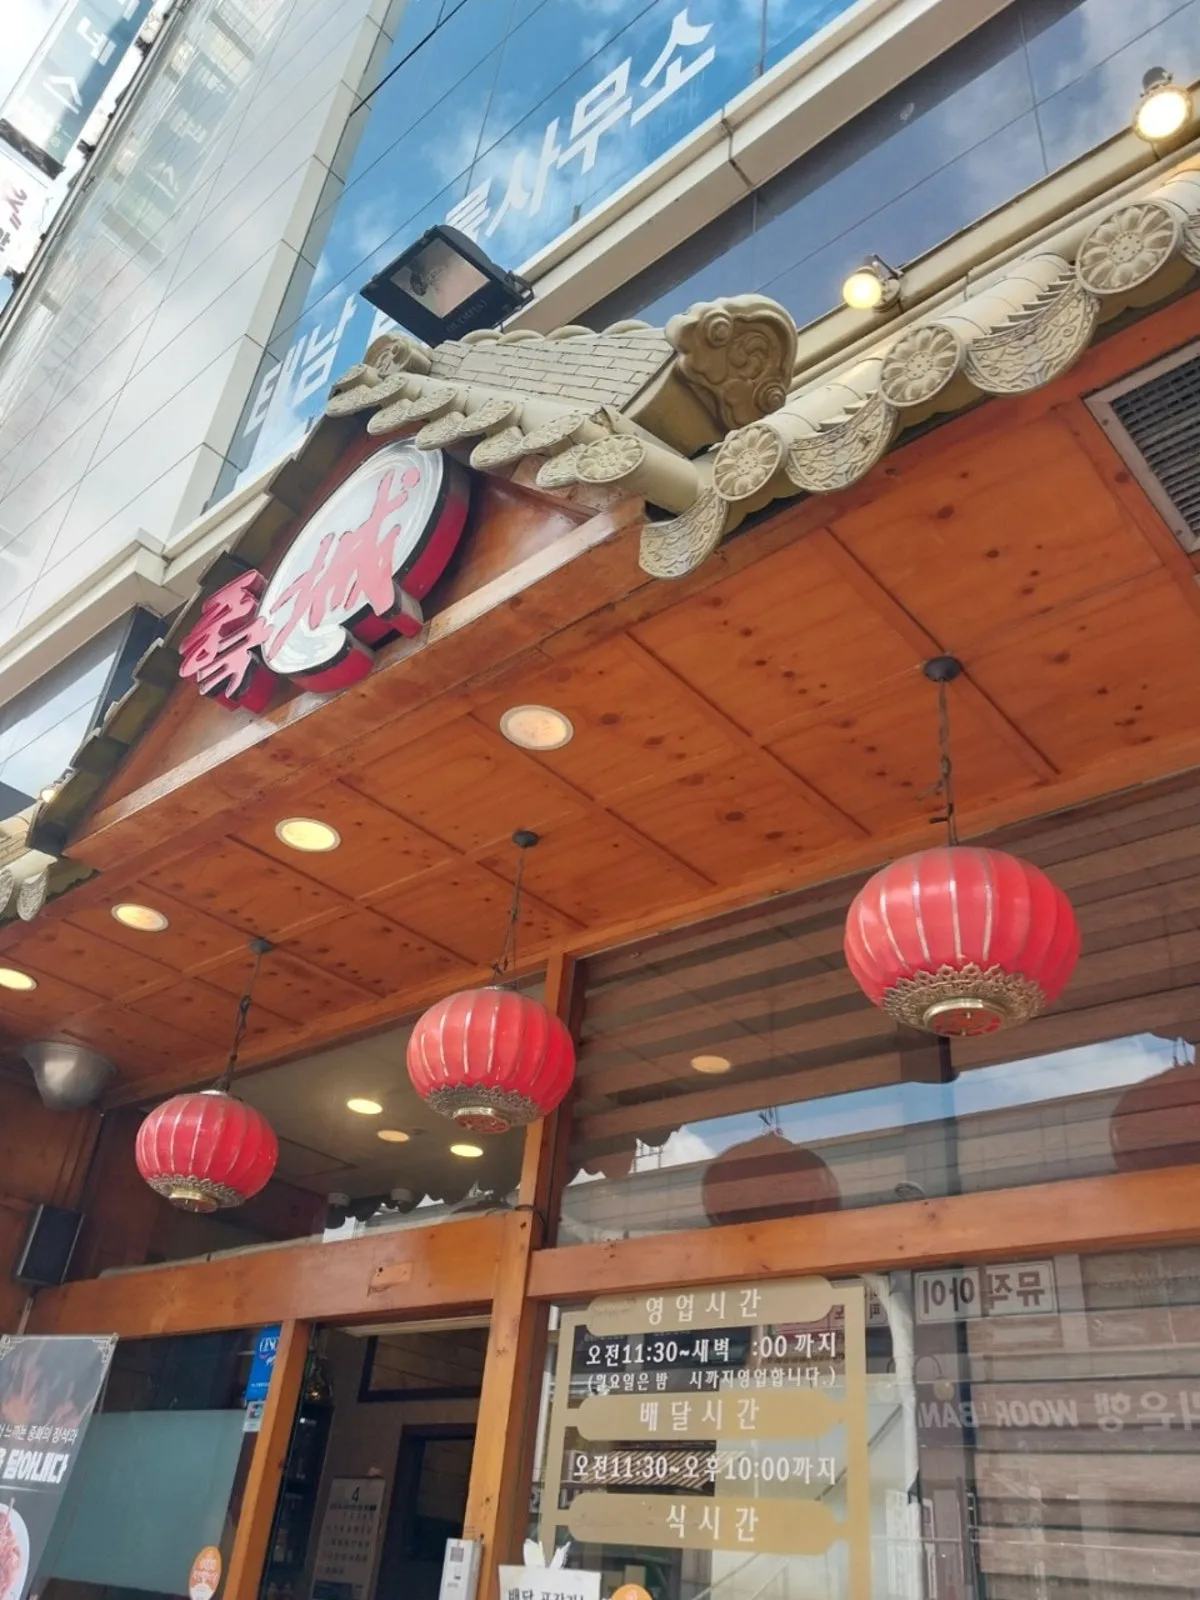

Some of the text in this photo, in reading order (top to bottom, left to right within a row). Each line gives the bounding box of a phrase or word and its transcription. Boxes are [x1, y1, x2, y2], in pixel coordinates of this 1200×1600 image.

[645, 1288, 762, 1325] 영업시간
[639, 1398, 760, 1431] 배달시간
[351, 1486, 360, 1503] 4
[666, 1504, 760, 1542] 식시간
